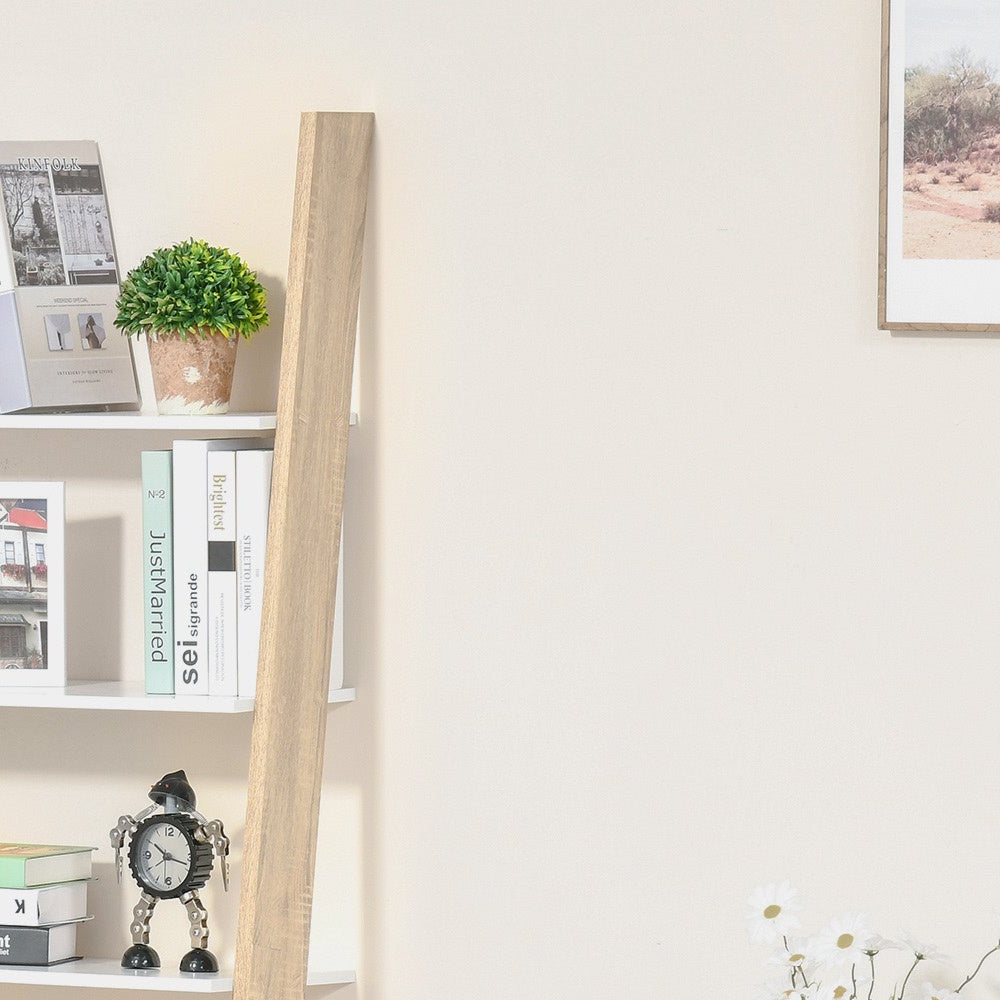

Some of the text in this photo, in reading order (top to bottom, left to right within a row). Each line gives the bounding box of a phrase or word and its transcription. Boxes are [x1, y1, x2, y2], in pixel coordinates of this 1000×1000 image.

[18, 157, 81, 171] KINFOLK
[210, 475, 226, 530] Brightest
[150, 530, 167, 662] JustMarried
[177, 573, 200, 684] sei sigrande
[165, 827, 174, 837] 12
[145, 851, 151, 859] 9
[165, 877, 172, 886] 6
